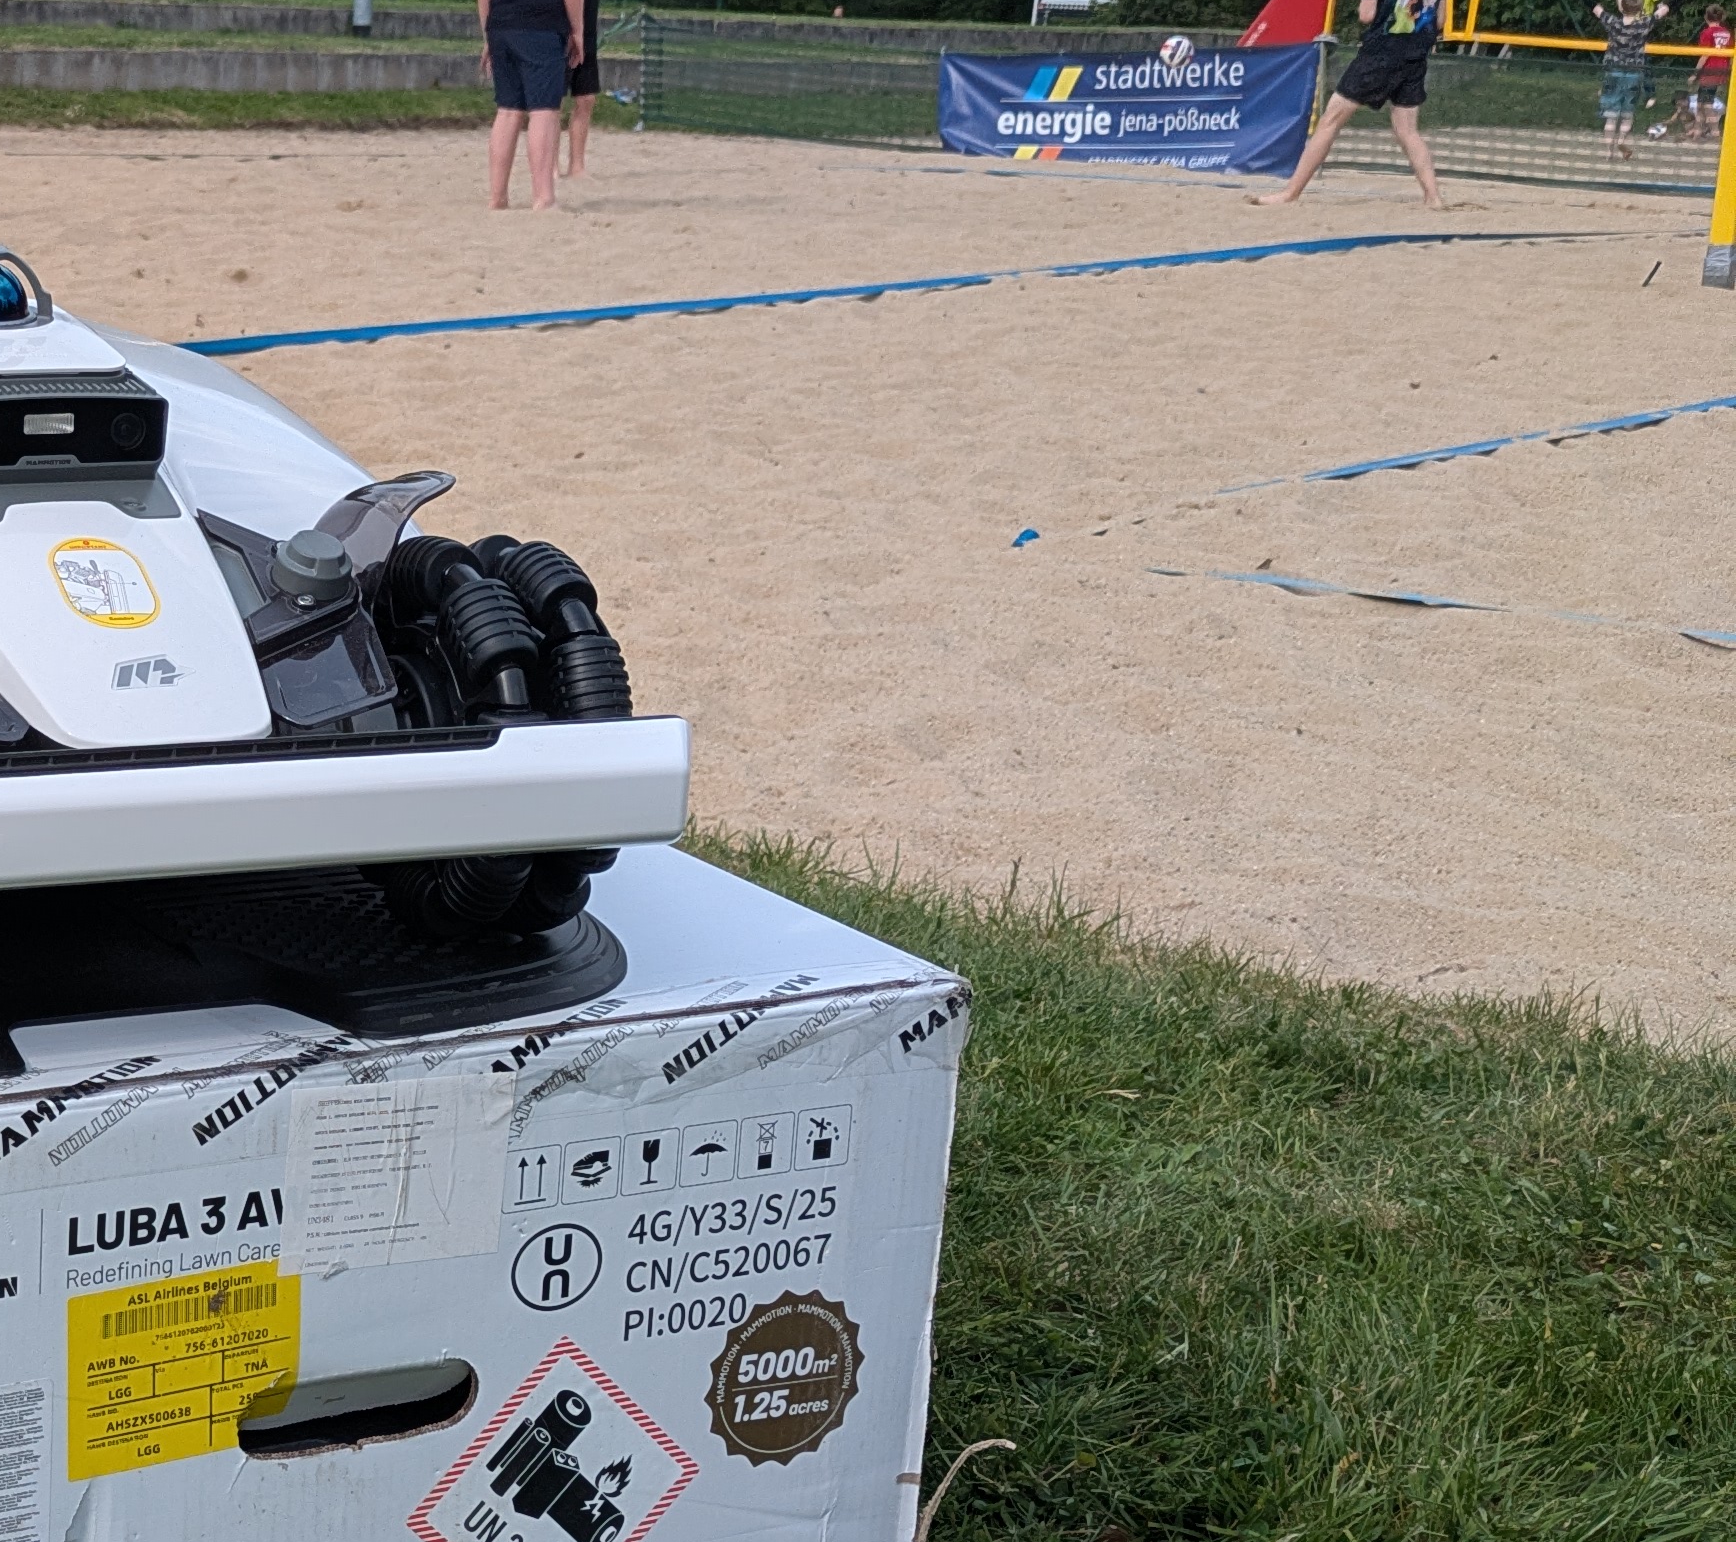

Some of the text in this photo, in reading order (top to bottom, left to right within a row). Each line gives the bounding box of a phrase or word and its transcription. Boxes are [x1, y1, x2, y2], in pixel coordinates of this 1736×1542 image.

[1094, 54, 1244, 91] stadtwerke
[997, 104, 1240, 143] energie jena-pößneck
[68, 1202, 189, 1255] LUBA
[200, 1196, 226, 1235] 3
[628, 1186, 837, 1246] 4G/Y33/S/25
[66, 1243, 280, 1289] Redefining Lawn Care
[626, 1233, 832, 1293] CN/C520067
[128, 1274, 252, 1307] ASL Airlines Belgium
[623, 1293, 747, 1341] PI:0020
[740, 1305, 792, 1342] MAMMOTION
[797, 1304, 842, 1333] MAMMOTION
[87, 1328, 269, 1373] AWB No. 756-61207020
[244, 1359, 269, 1373] TNA
[840, 1332, 853, 1389] MAMMOTION
[717, 1344, 741, 1404] MAMMOTION
[108, 1387, 132, 1401] LGG
[734, 1389, 829, 1423] 1.25 acres
[137, 1443, 161, 1457] LGG
